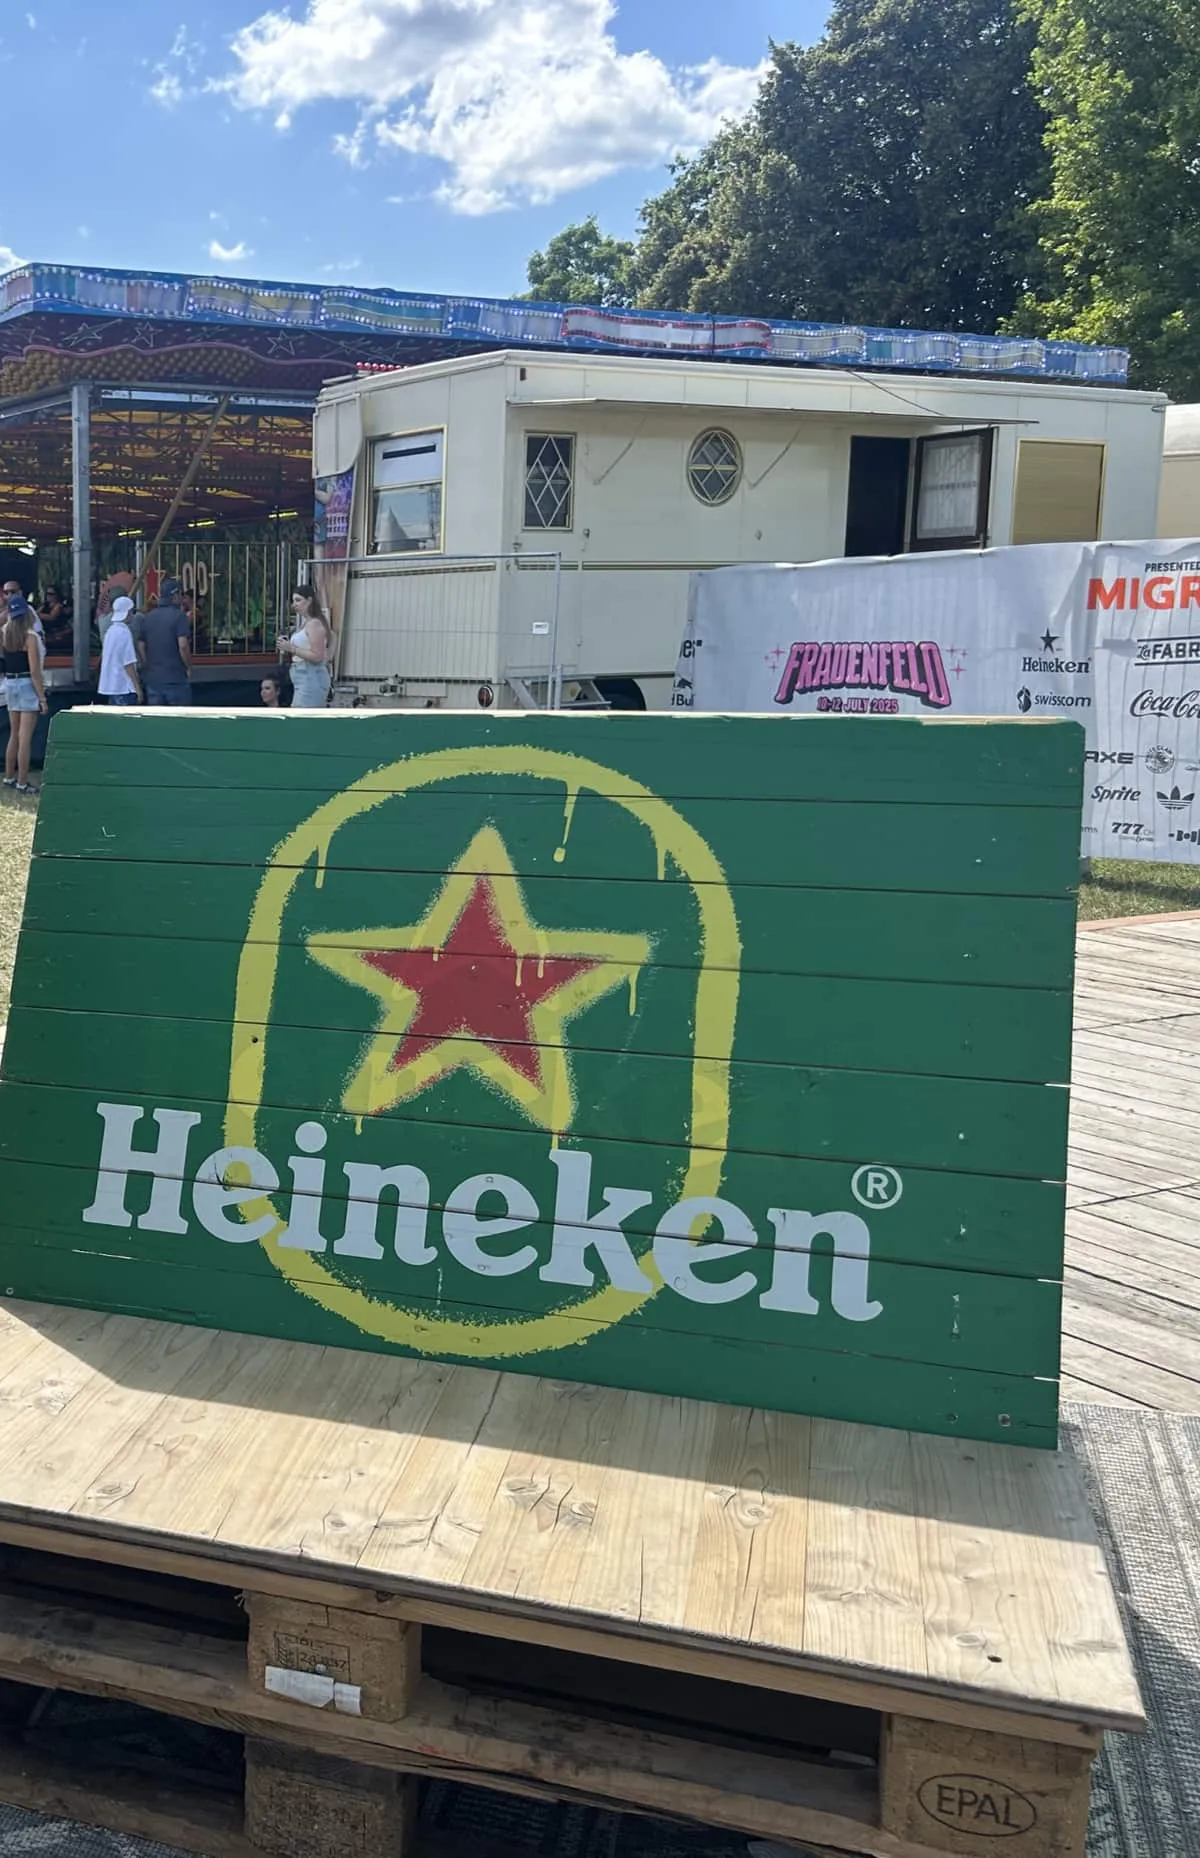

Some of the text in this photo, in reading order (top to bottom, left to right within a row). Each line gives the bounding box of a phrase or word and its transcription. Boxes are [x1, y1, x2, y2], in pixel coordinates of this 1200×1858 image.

[1086, 576, 1200, 610] MIGR
[1152, 642, 1200, 659] FABR
[1022, 656, 1090, 673] Heineken
[775, 641, 952, 709] FRAUENFELD
[843, 698, 870, 713] JULY
[871, 698, 898, 713] 2025
[1034, 692, 1092, 707] swisscom
[1084, 750, 1134, 764] AXE
[1091, 785, 1141, 803] Sprite
[81, 1101, 884, 1322] Heineken
[936, 1783, 1022, 1829] EPAL
